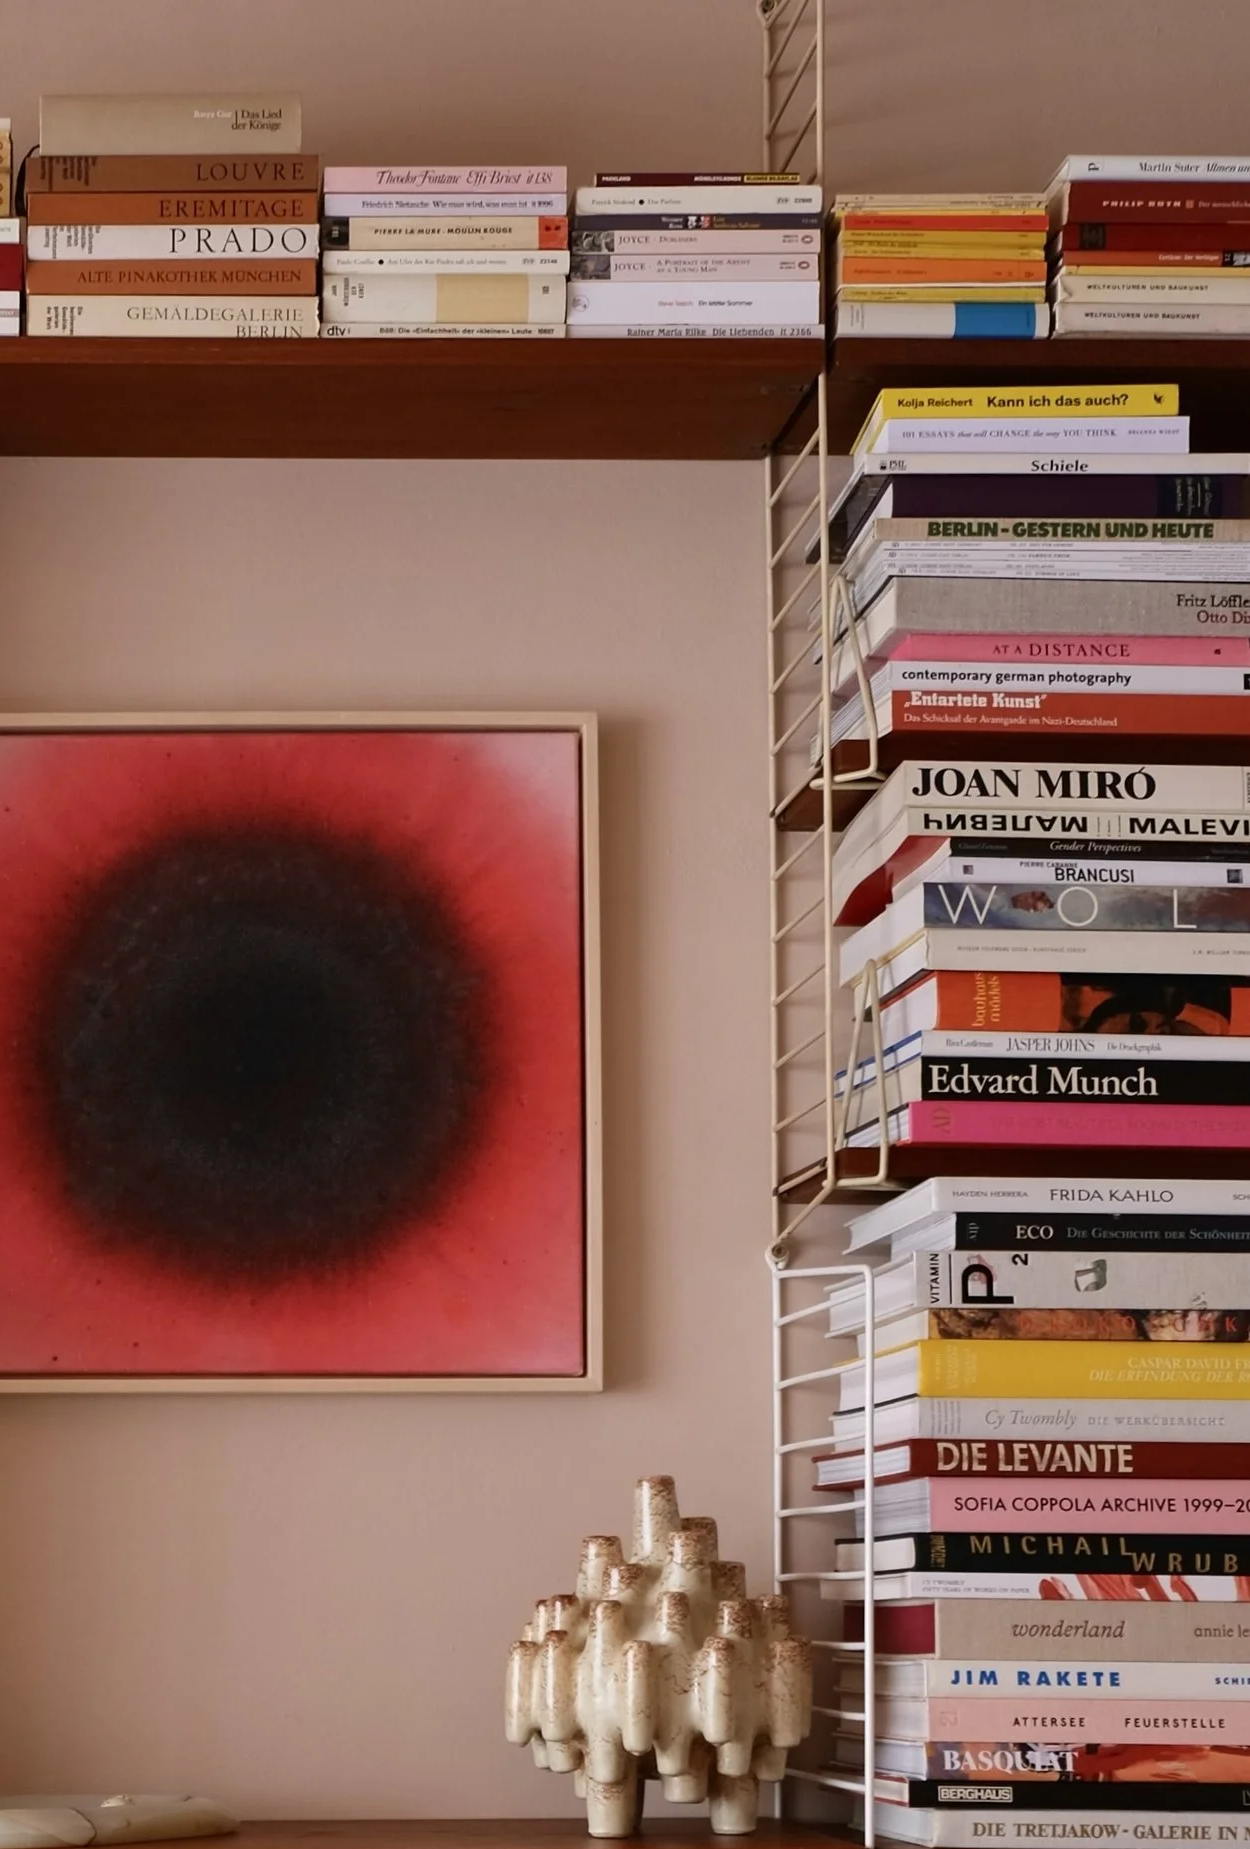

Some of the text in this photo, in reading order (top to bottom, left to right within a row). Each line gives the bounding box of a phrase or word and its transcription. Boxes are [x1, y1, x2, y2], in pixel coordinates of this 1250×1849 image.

[241, 108, 283, 119] Das Lied
[232, 119, 282, 132] der Könige
[196, 162, 305, 183] LOUVRE
[377, 170, 417, 186] Theodor
[419, 171, 461, 186] Fontane
[467, 170, 488, 186] Effi
[491, 171, 520, 185] Briest
[159, 199, 305, 218] EREMITAGE
[447, 226, 476, 234] MOULIN
[169, 227, 307, 254] PRADO
[77, 268, 302, 284] ALTE PINAKOTHEK MÜNCHEN
[127, 304, 303, 322] GEMÄLDEGALERIE
[236, 325, 303, 339] BERLIN
[898, 393, 1129, 409] Kolja Reichert Kann ich das auch?
[1031, 459, 1089, 473] Schiele
[928, 522, 1214, 538] BERLIN GESTERN UND HEUTE
[912, 766, 1157, 800] JOAN MIRÓ
[1054, 867, 1135, 883] BRANCUSI
[928, 1063, 1159, 1096] Edvard Munch
[1050, 1189, 1174, 1203] FRIDA KAHLO
[951, 1670, 1121, 1687] JIM RAKETE
[1013, 1717, 1226, 1729] ATTERSEE FEUERSTELLE
[940, 1787, 1011, 1801] BERGHAUS
